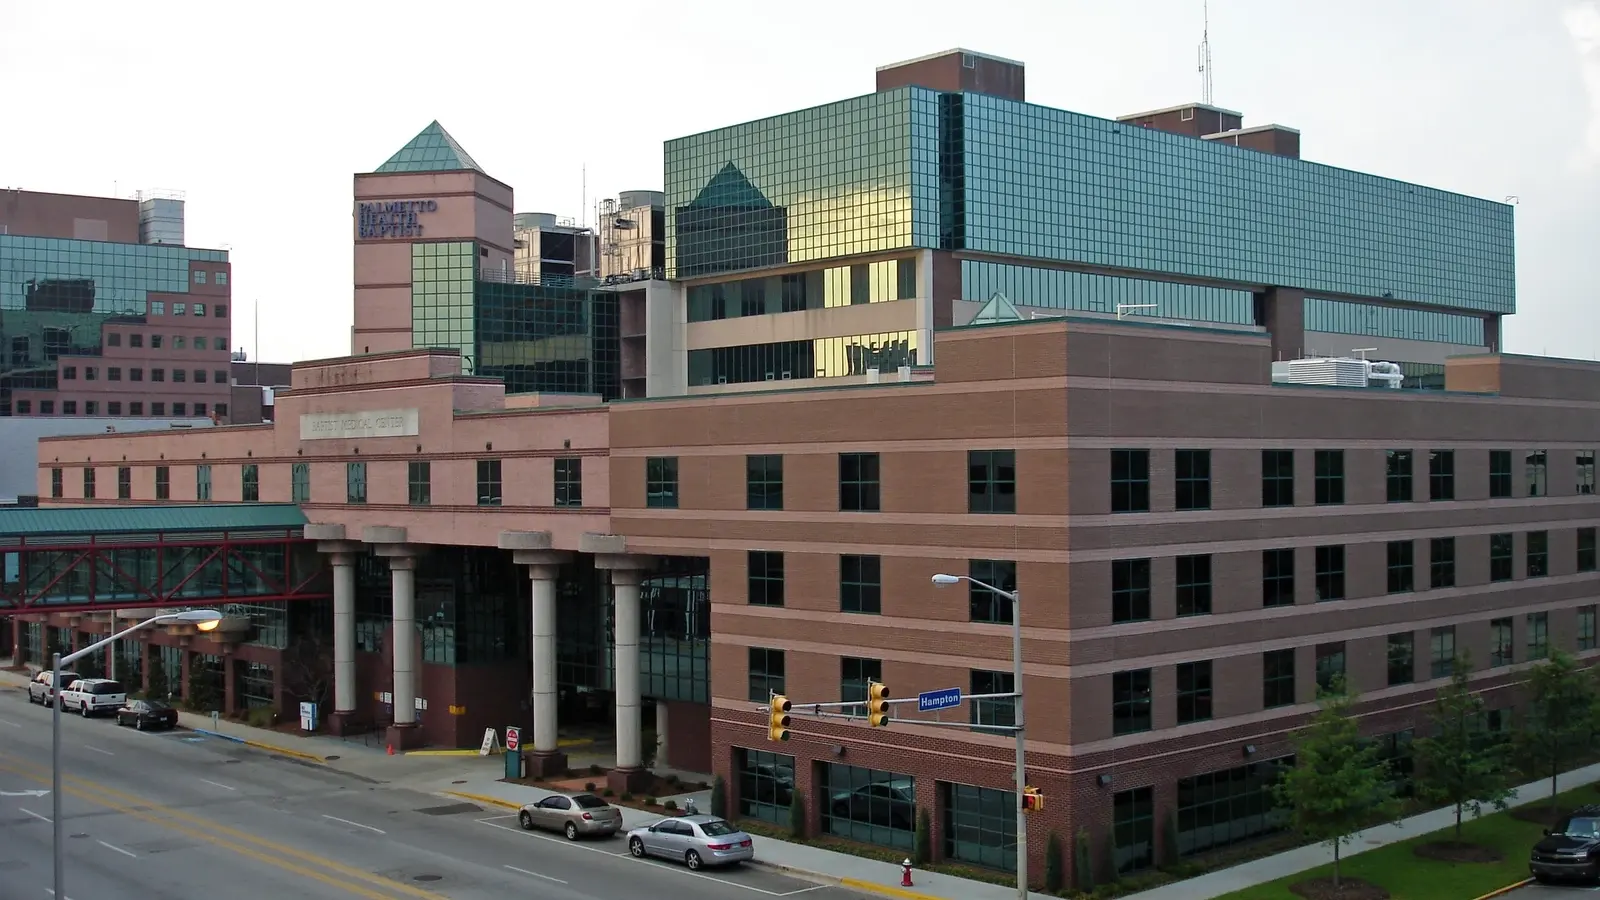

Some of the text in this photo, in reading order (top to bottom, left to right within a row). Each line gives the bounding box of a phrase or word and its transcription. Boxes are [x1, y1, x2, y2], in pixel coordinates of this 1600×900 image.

[358, 200, 437, 213] PALMETTO
[358, 212, 417, 225] HEALTH
[358, 224, 423, 238] BAPTIST
[341, 418, 373, 430] MEDICAL
[376, 416, 404, 428] CENTER
[921, 694, 959, 707] Hampton
